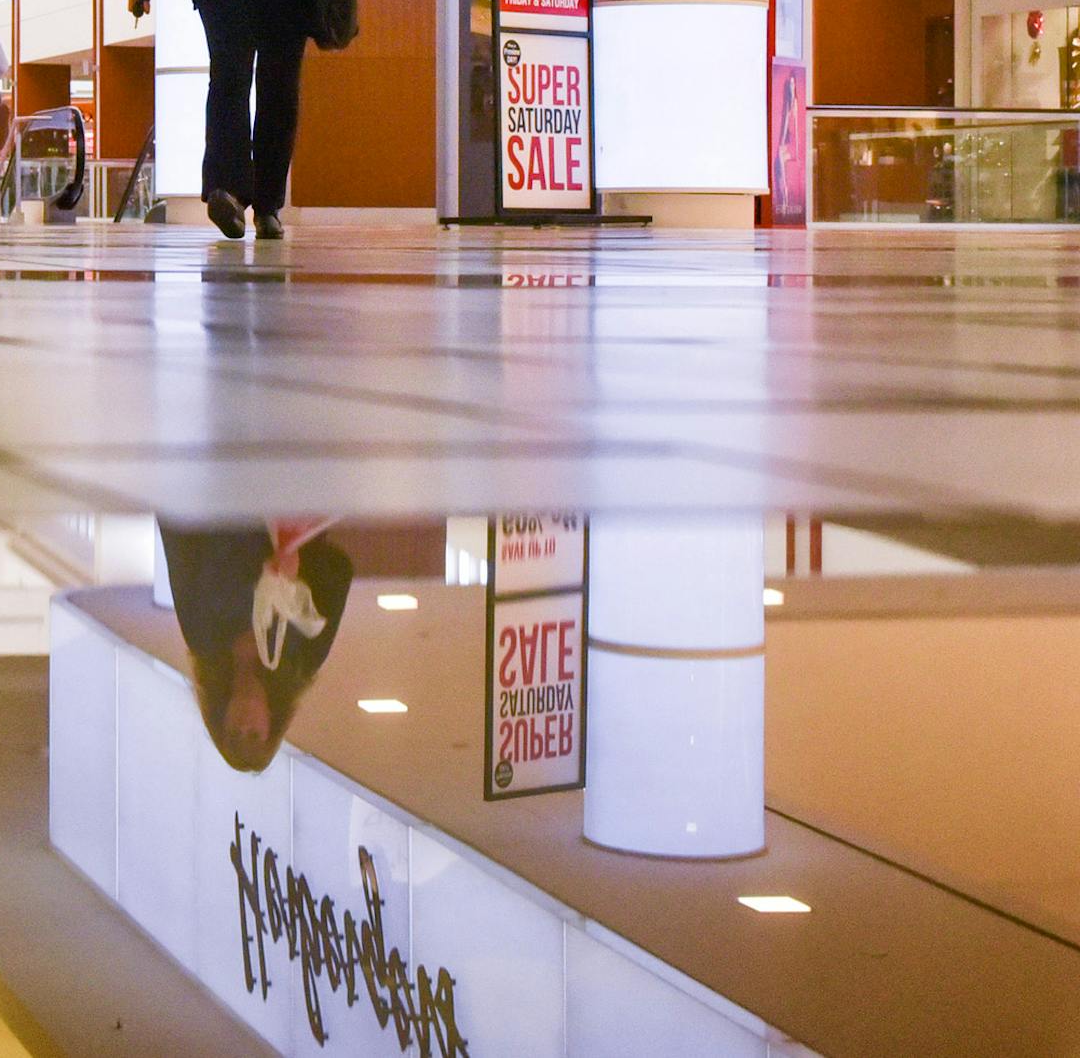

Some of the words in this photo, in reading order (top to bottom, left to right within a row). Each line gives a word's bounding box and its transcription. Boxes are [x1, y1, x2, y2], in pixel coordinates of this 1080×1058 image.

[507, 63, 581, 107] SUPER
[508, 107, 581, 135] SATURDAY
[507, 136, 582, 191] SALE
